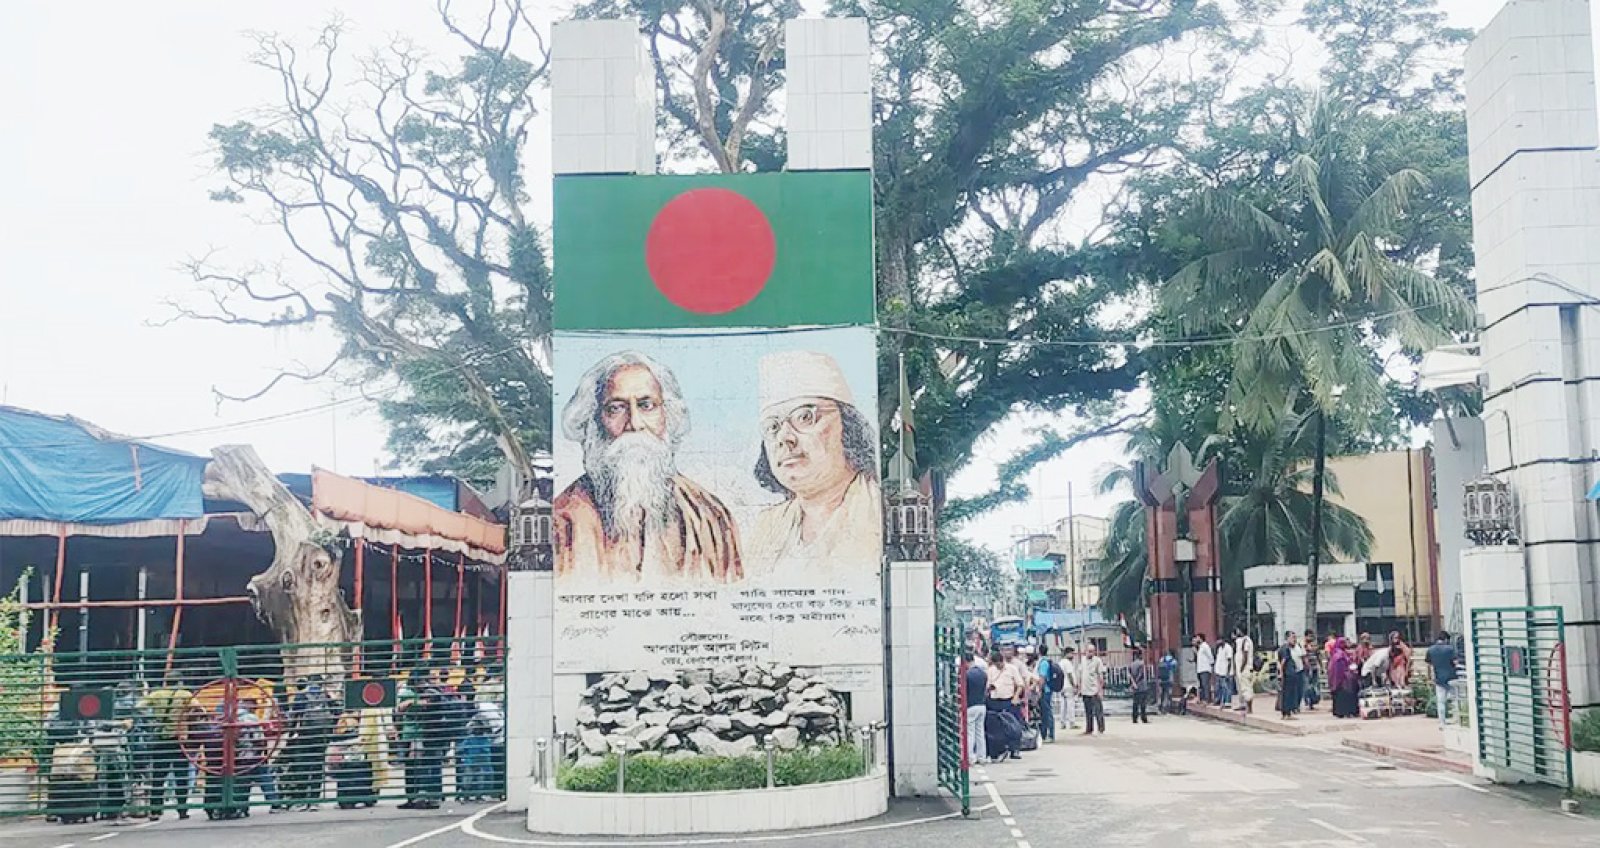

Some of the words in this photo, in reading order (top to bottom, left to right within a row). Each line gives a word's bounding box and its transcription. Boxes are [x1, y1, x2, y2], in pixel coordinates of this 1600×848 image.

[558, 594, 595, 603] আবার
[633, 590, 654, 601] যদি
[621, 609, 652, 618] মাঝে
[643, 644, 699, 656] আশরাফুল
[703, 643, 737, 652] আলম
[740, 639, 769, 651] লিটন
